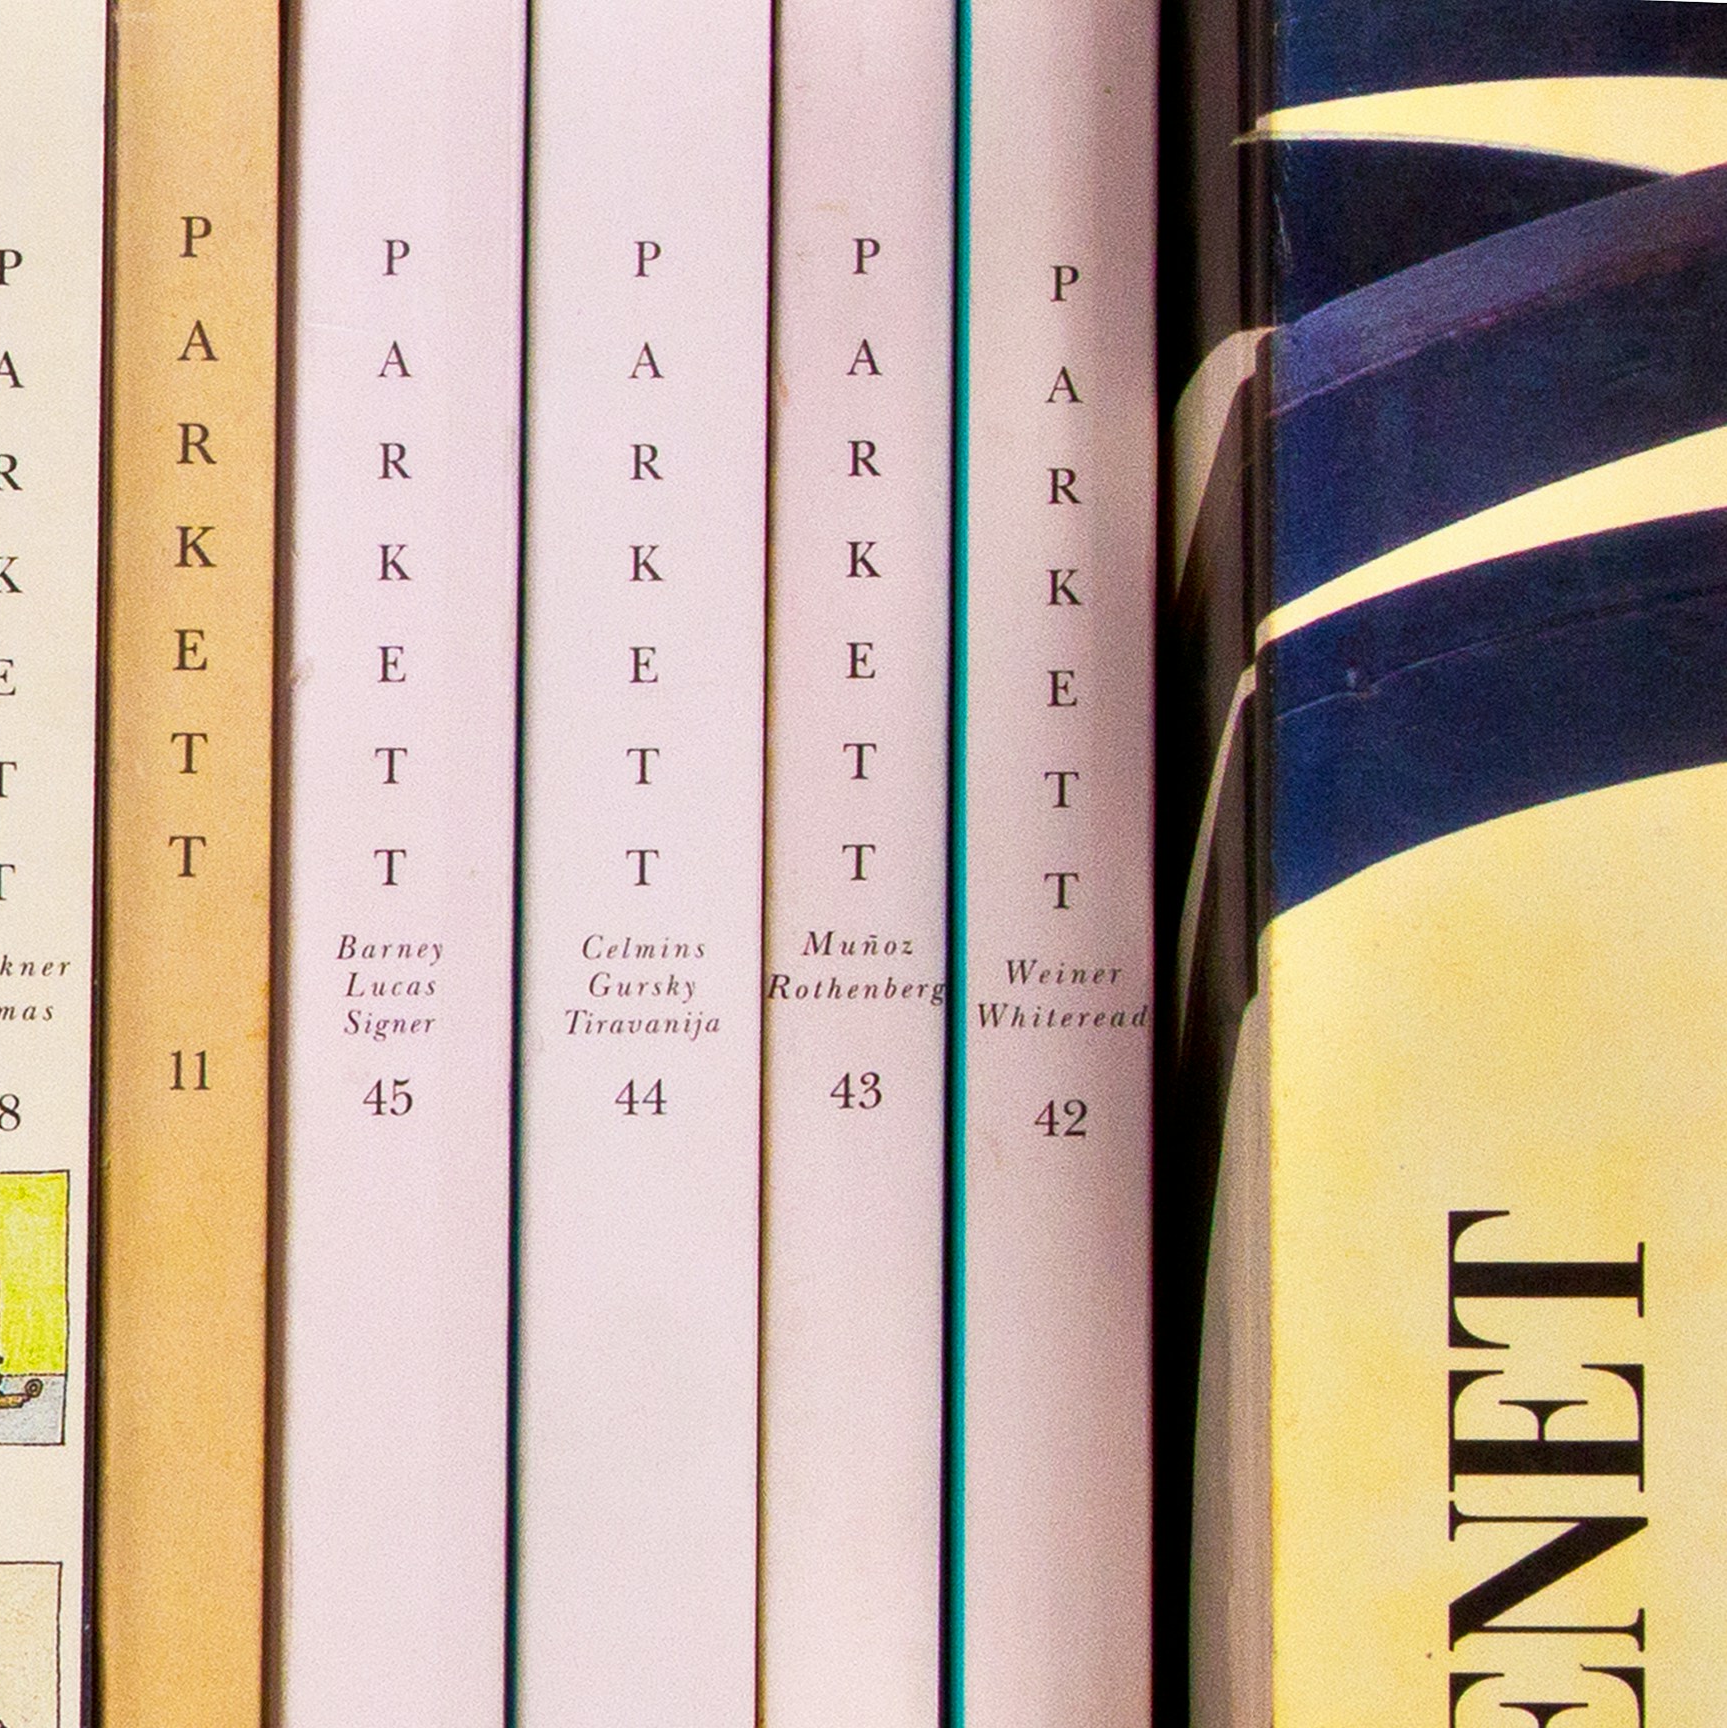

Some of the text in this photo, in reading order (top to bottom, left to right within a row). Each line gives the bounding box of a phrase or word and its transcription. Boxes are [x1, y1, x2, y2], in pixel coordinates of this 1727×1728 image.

[168, 215, 218, 878] PARKETT
[374, 239, 411, 887] PARKETT
[625, 240, 663, 887] PARKETT
[842, 237, 881, 881] PARKETT
[1044, 265, 1081, 910] PARKETT
[337, 933, 445, 966] Barney
[581, 933, 706, 962] Celmins
[802, 930, 913, 956] Muñoz
[346, 972, 437, 999] Lucas
[587, 971, 697, 1004] Gursky
[768, 974, 942, 1006] Rothenberg
[1005, 959, 1123, 987] Weiner
[343, 1009, 435, 1041] Signer
[564, 1009, 720, 1041] Tiravanija
[977, 1002, 1149, 1030] Whiteread
[170, 1050, 209, 1091] 11
[363, 1079, 414, 1116] 45
[615, 1078, 666, 1116] 44
[830, 1071, 883, 1110] 43
[1034, 1099, 1088, 1137] 42
